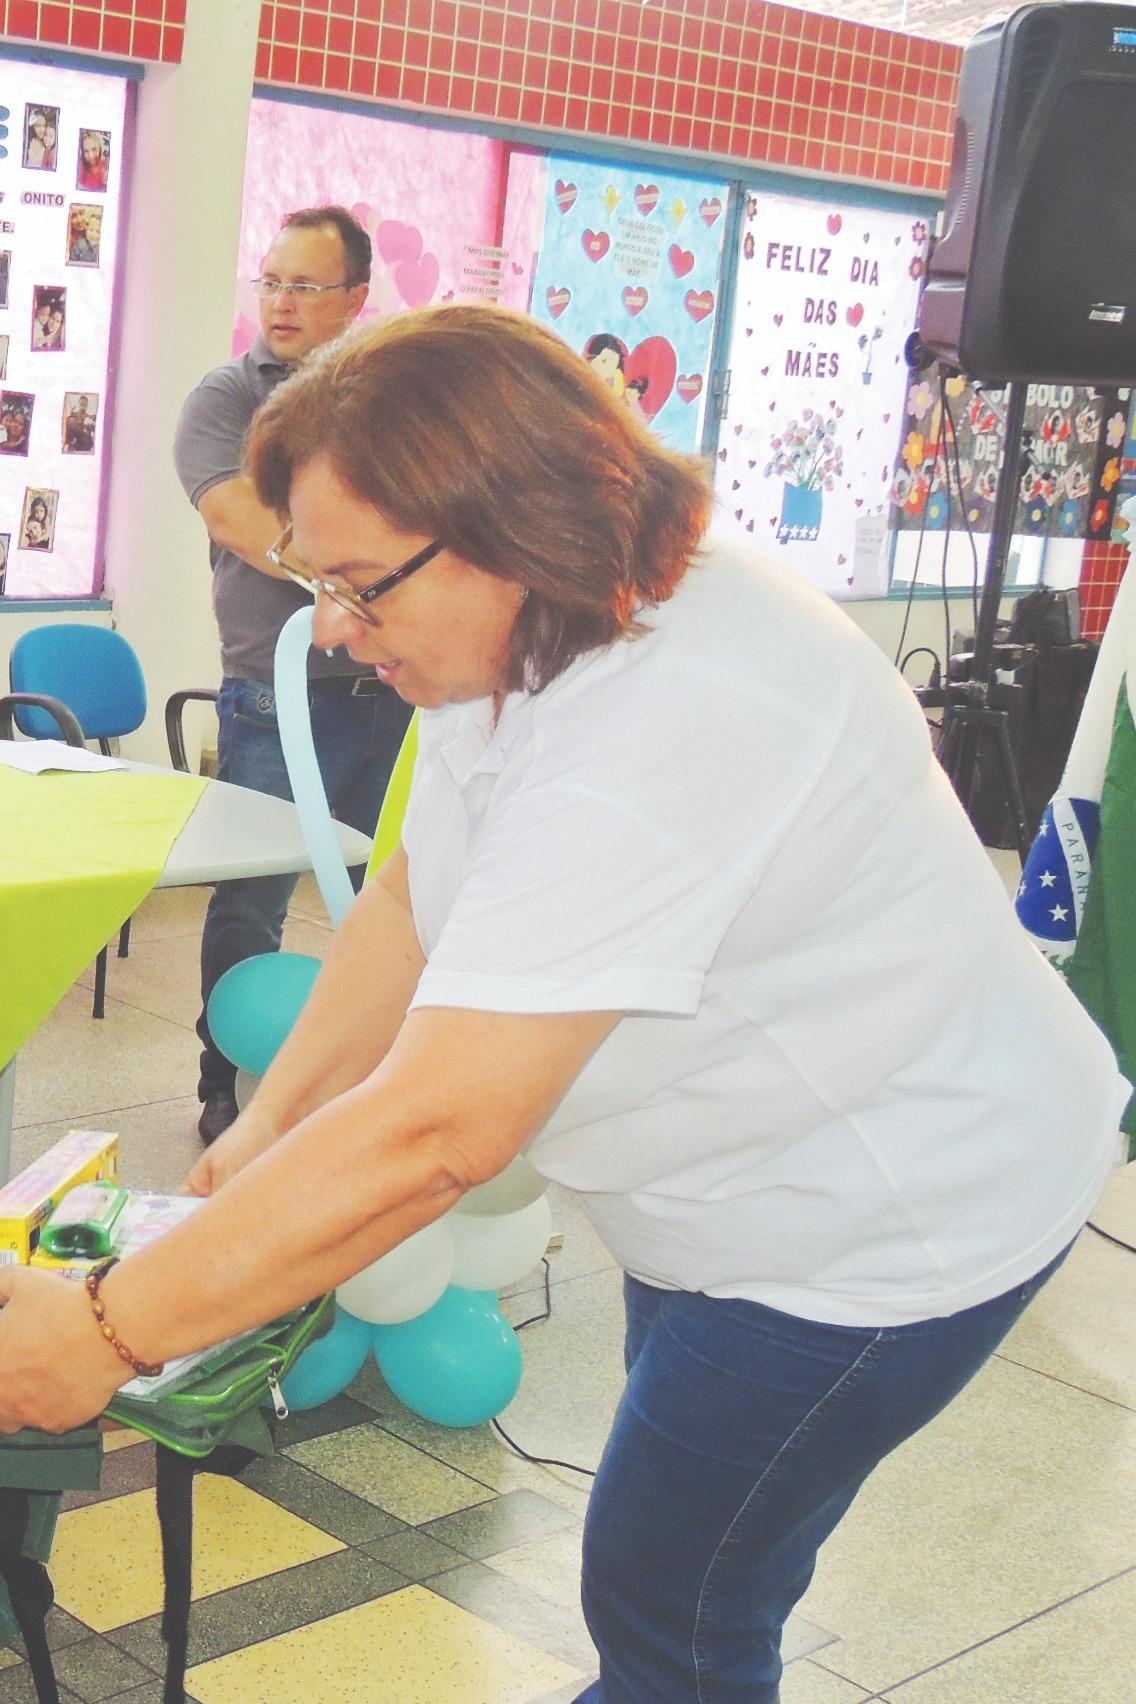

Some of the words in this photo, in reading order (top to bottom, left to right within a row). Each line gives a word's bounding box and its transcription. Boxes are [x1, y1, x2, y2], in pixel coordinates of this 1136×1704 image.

[766, 242, 831, 276] FELIZ
[850, 256, 878, 286] DIA
[804, 298, 837, 325] DAS
[785, 342, 839, 378] MÃES
[974, 436, 998, 461] DE
